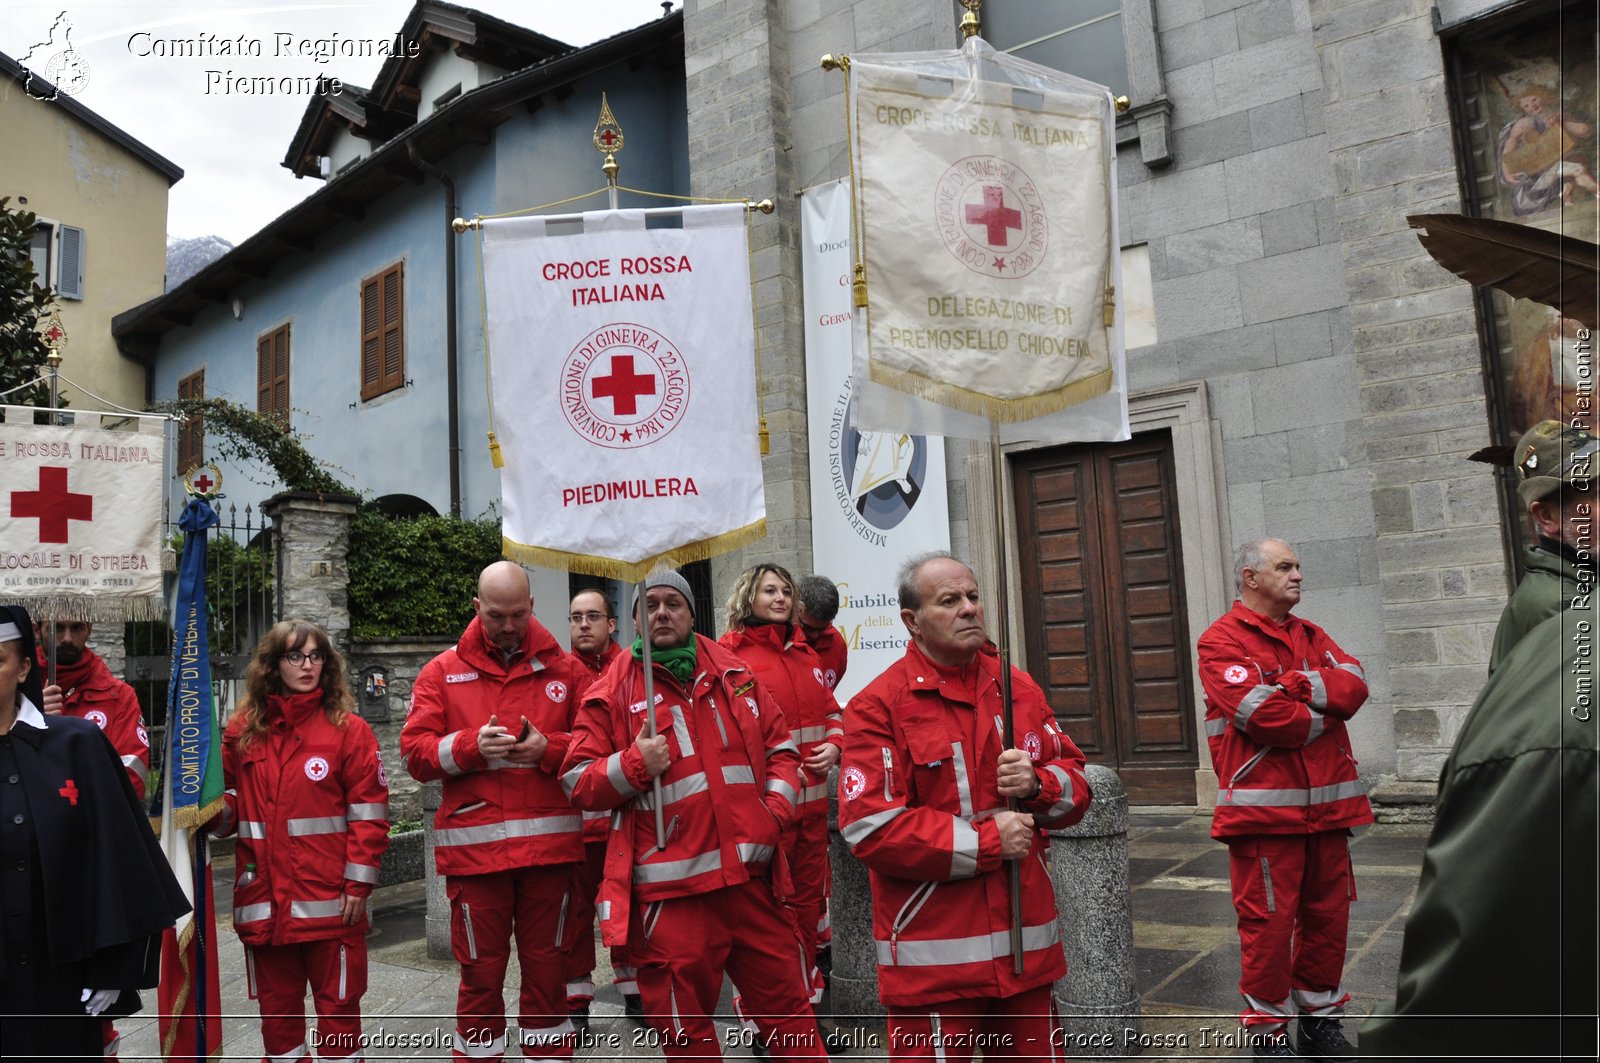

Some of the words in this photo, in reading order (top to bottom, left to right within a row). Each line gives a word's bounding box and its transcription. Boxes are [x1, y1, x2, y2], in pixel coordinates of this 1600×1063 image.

[876, 105, 932, 126] CROCE
[943, 112, 1003, 138] ROSSA
[1012, 121, 1089, 146] ITALIANA
[1019, 182, 1036, 201] 22
[542, 260, 611, 281] CROCE
[621, 255, 692, 275] ROSSA
[572, 283, 665, 306] ITALIANA
[927, 296, 1048, 325] DELEGAZIONE
[1055, 307, 1073, 325] DI
[595, 328, 659, 353] GINEVRA
[889, 326, 1009, 351] PREMOSELLO
[579, 342, 597, 361] DI
[658, 351, 677, 368] 22
[565, 359, 616, 441] CONVENZIONE
[660, 369, 684, 421] AGOSTO
[838, 392, 849, 408] IL
[636, 417, 665, 440] 1864
[829, 408, 843, 449] COME
[15, 441, 72, 459] ROSSA
[80, 443, 151, 463] ITALIANA
[563, 477, 698, 507] PIEDIMULERA
[829, 453, 887, 547] MISERICORDIOSI
[69, 553, 82, 570] DI
[91, 554, 148, 571] STRESA
[320, 562, 328, 575] 5
[4, 577, 21, 586] DAL
[27, 576, 61, 586] GRUPPO
[66, 577, 90, 587] ALPINI
[102, 578, 135, 587] STRESA
[864, 615, 893, 627] della
[181, 667, 199, 680] DI
[181, 727, 200, 794] COMITATO
